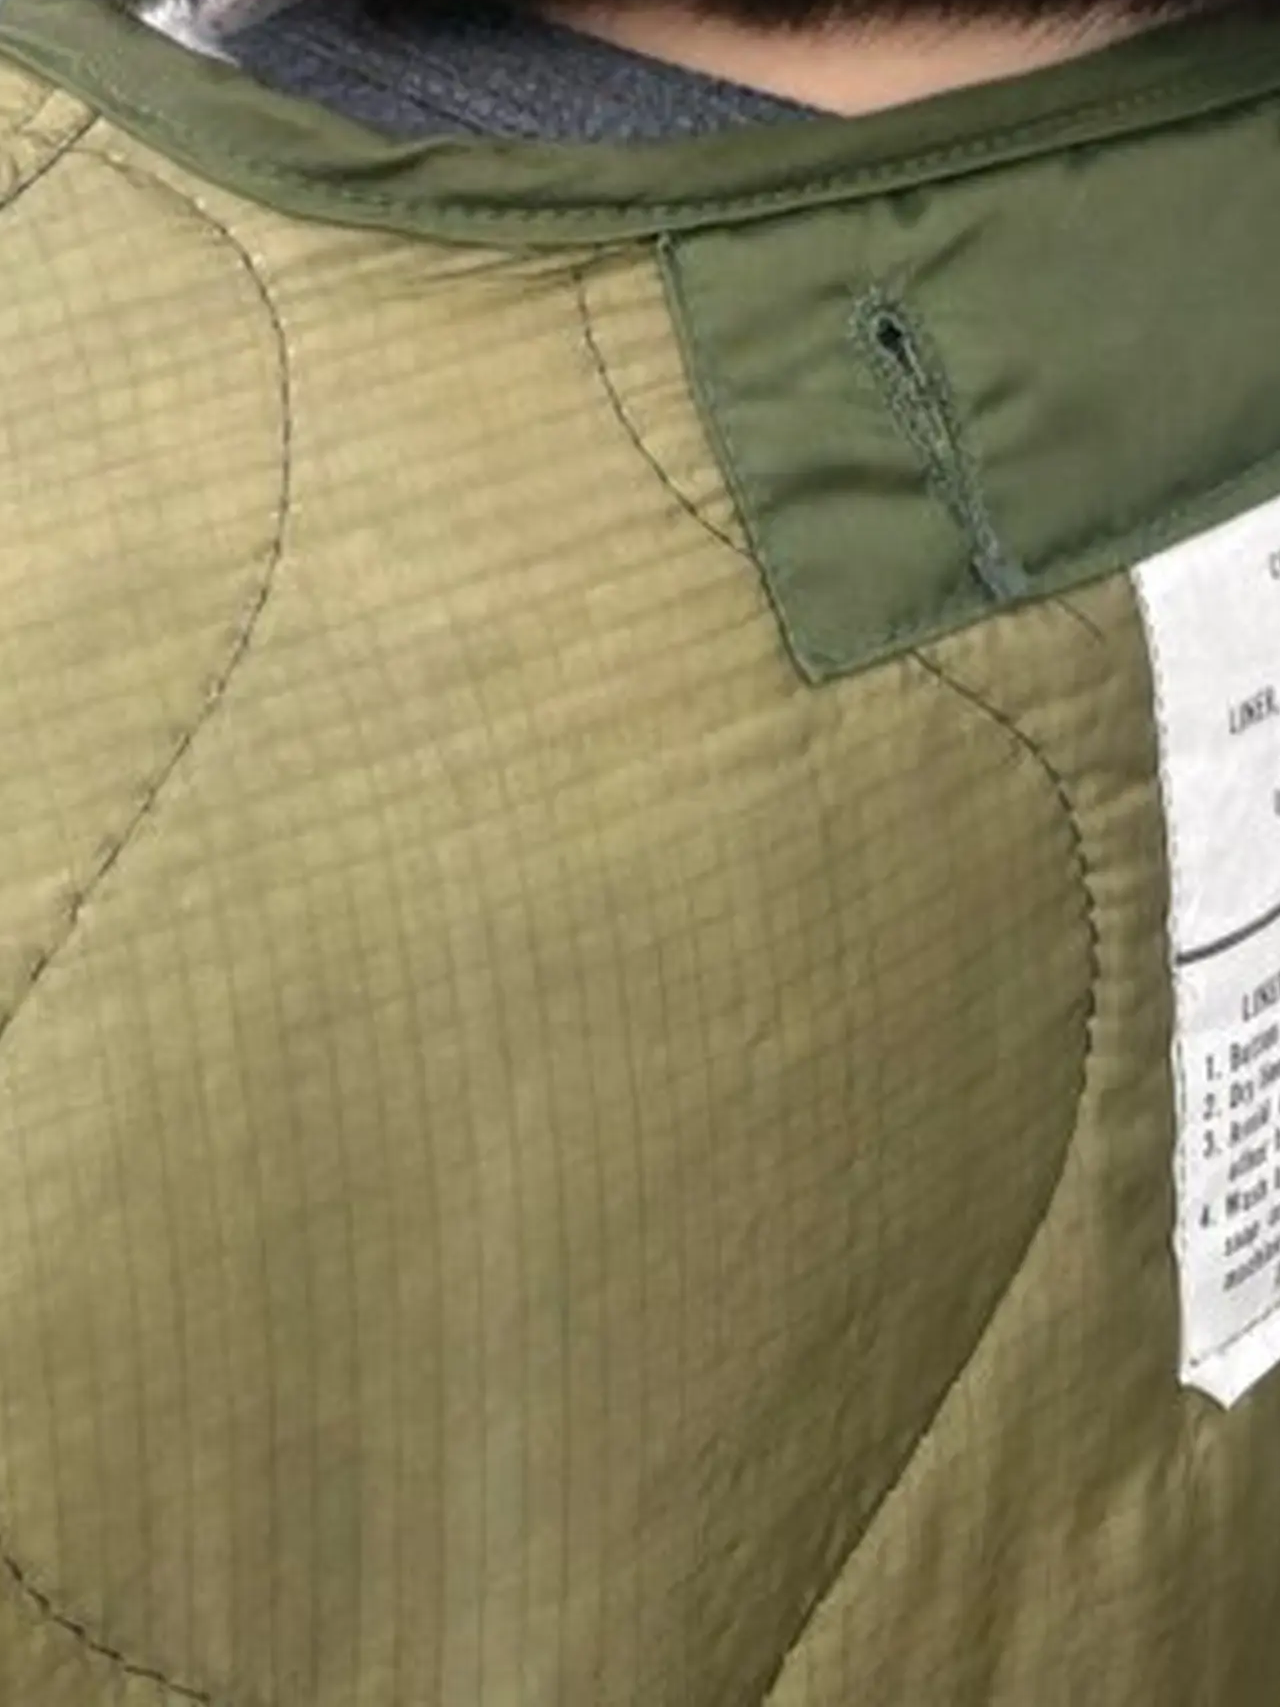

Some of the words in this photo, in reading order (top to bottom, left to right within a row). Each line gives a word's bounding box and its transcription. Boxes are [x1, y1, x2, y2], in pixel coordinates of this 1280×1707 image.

[1204, 1053, 1222, 1082] 1.
[1201, 1091, 1222, 1122] 2.
[1228, 1079, 1255, 1111] Dry
[1201, 1128, 1222, 1161] 3.
